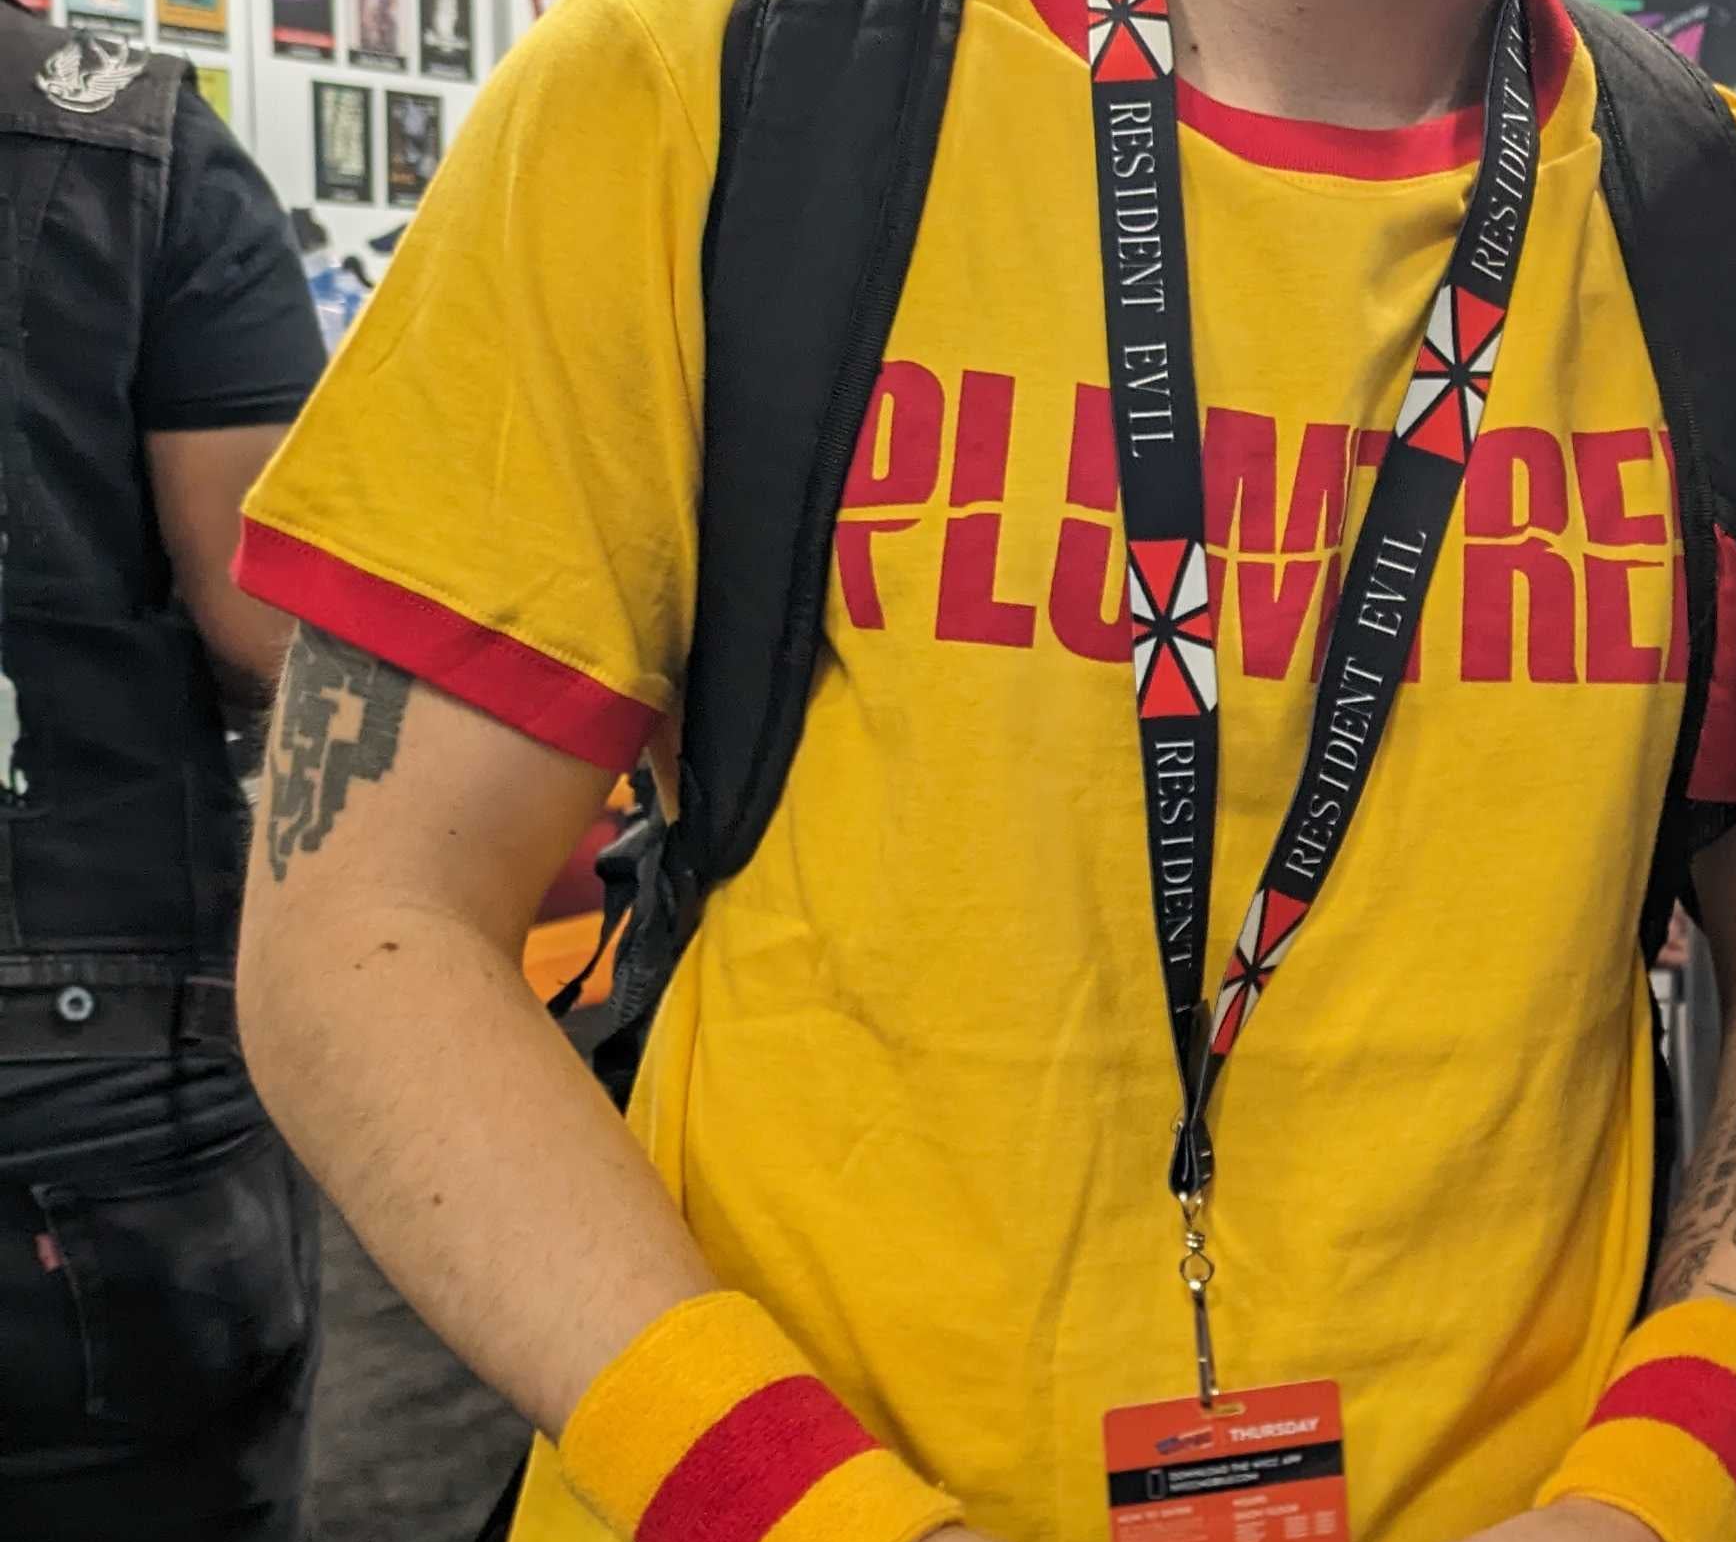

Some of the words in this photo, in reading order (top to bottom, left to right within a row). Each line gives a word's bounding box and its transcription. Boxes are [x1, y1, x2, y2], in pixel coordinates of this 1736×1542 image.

[1110, 102, 1165, 312] RESIDENT
[1470, 78, 1531, 283] RESIDENT
[1124, 343, 1174, 458] EVIL
[1284, 656, 1384, 881] RESIDENT
[1356, 529, 1427, 640] EVIL
[1153, 737, 1197, 967] RESIDENT
[1229, 1418, 1320, 1442] THURSDAY
